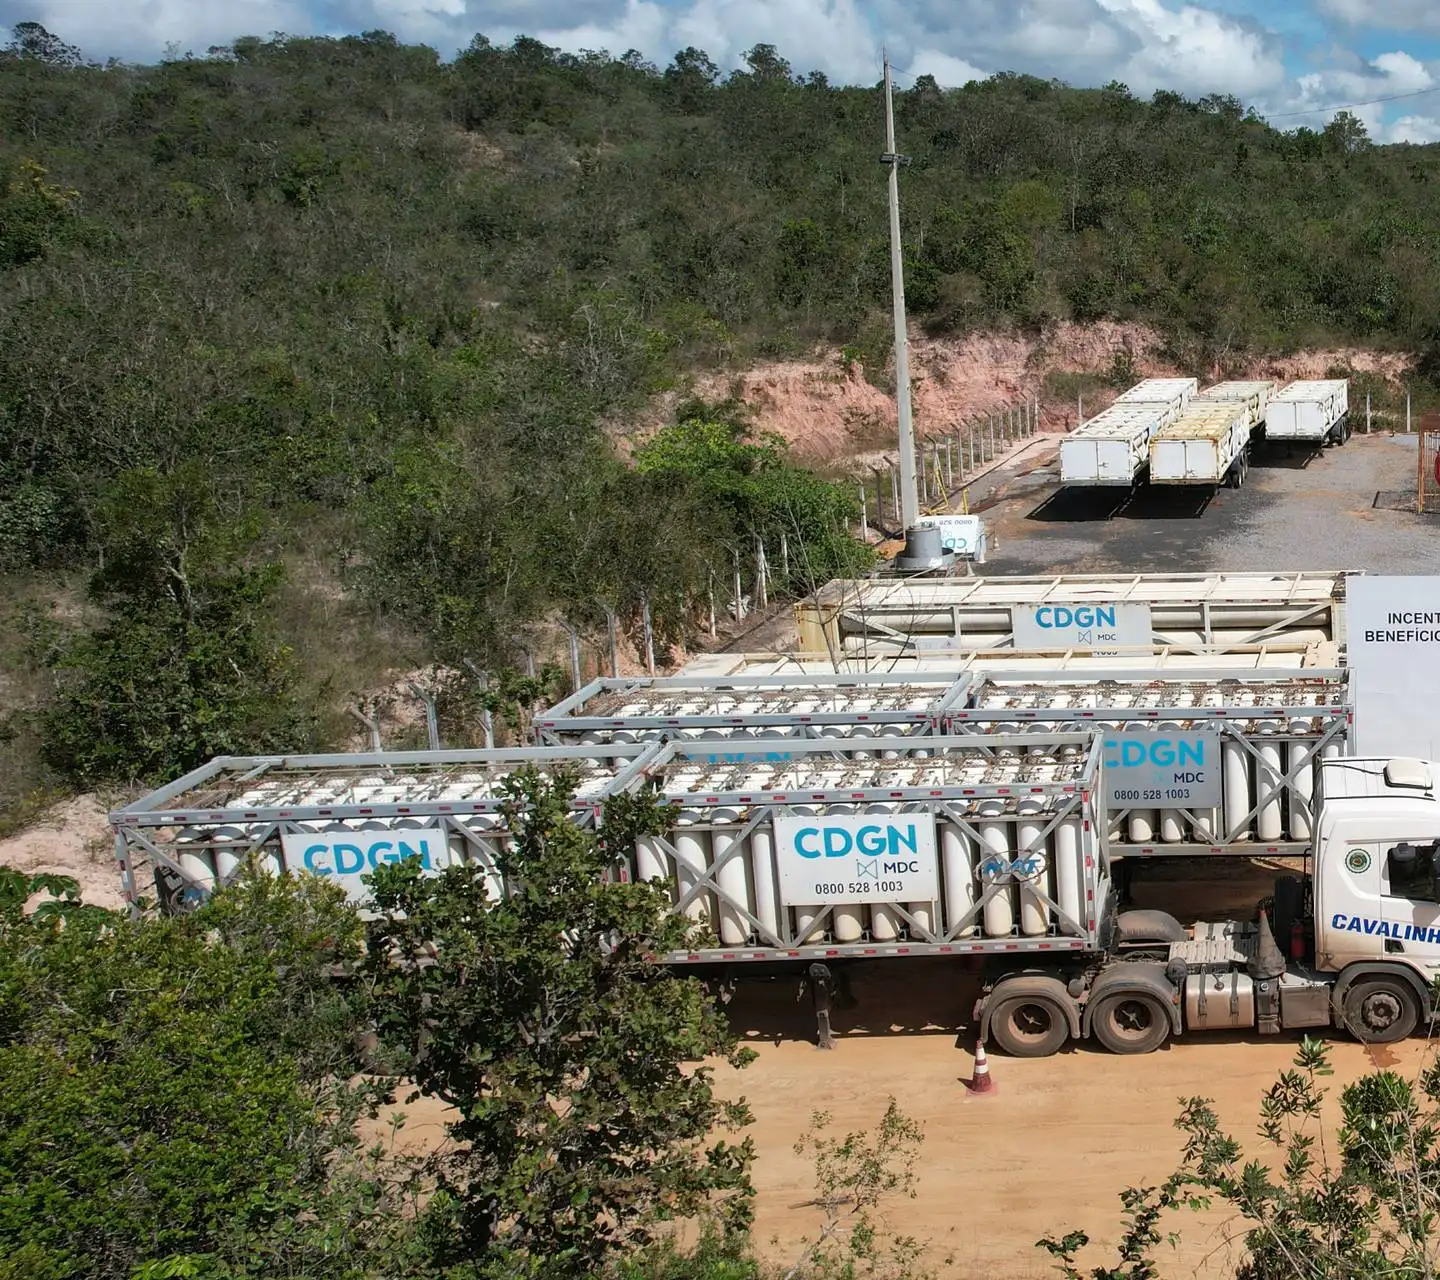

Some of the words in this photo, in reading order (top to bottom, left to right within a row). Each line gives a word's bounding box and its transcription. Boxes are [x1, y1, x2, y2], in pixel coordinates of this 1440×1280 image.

[945, 538, 967, 549] CD
[1035, 607, 1116, 628] CDGN
[1104, 739, 1205, 768] CDGN
[1174, 772, 1204, 783] MDC
[1114, 790, 1140, 800] 0800
[1143, 790, 1162, 800] 528
[1166, 789, 1190, 799] 1003
[794, 824, 918, 858] CDGN
[304, 840, 432, 876] CDGN
[884, 861, 919, 873] MDC
[815, 882, 844, 895] 0800
[848, 882, 870, 894] 528
[876, 881, 904, 892] 1003
